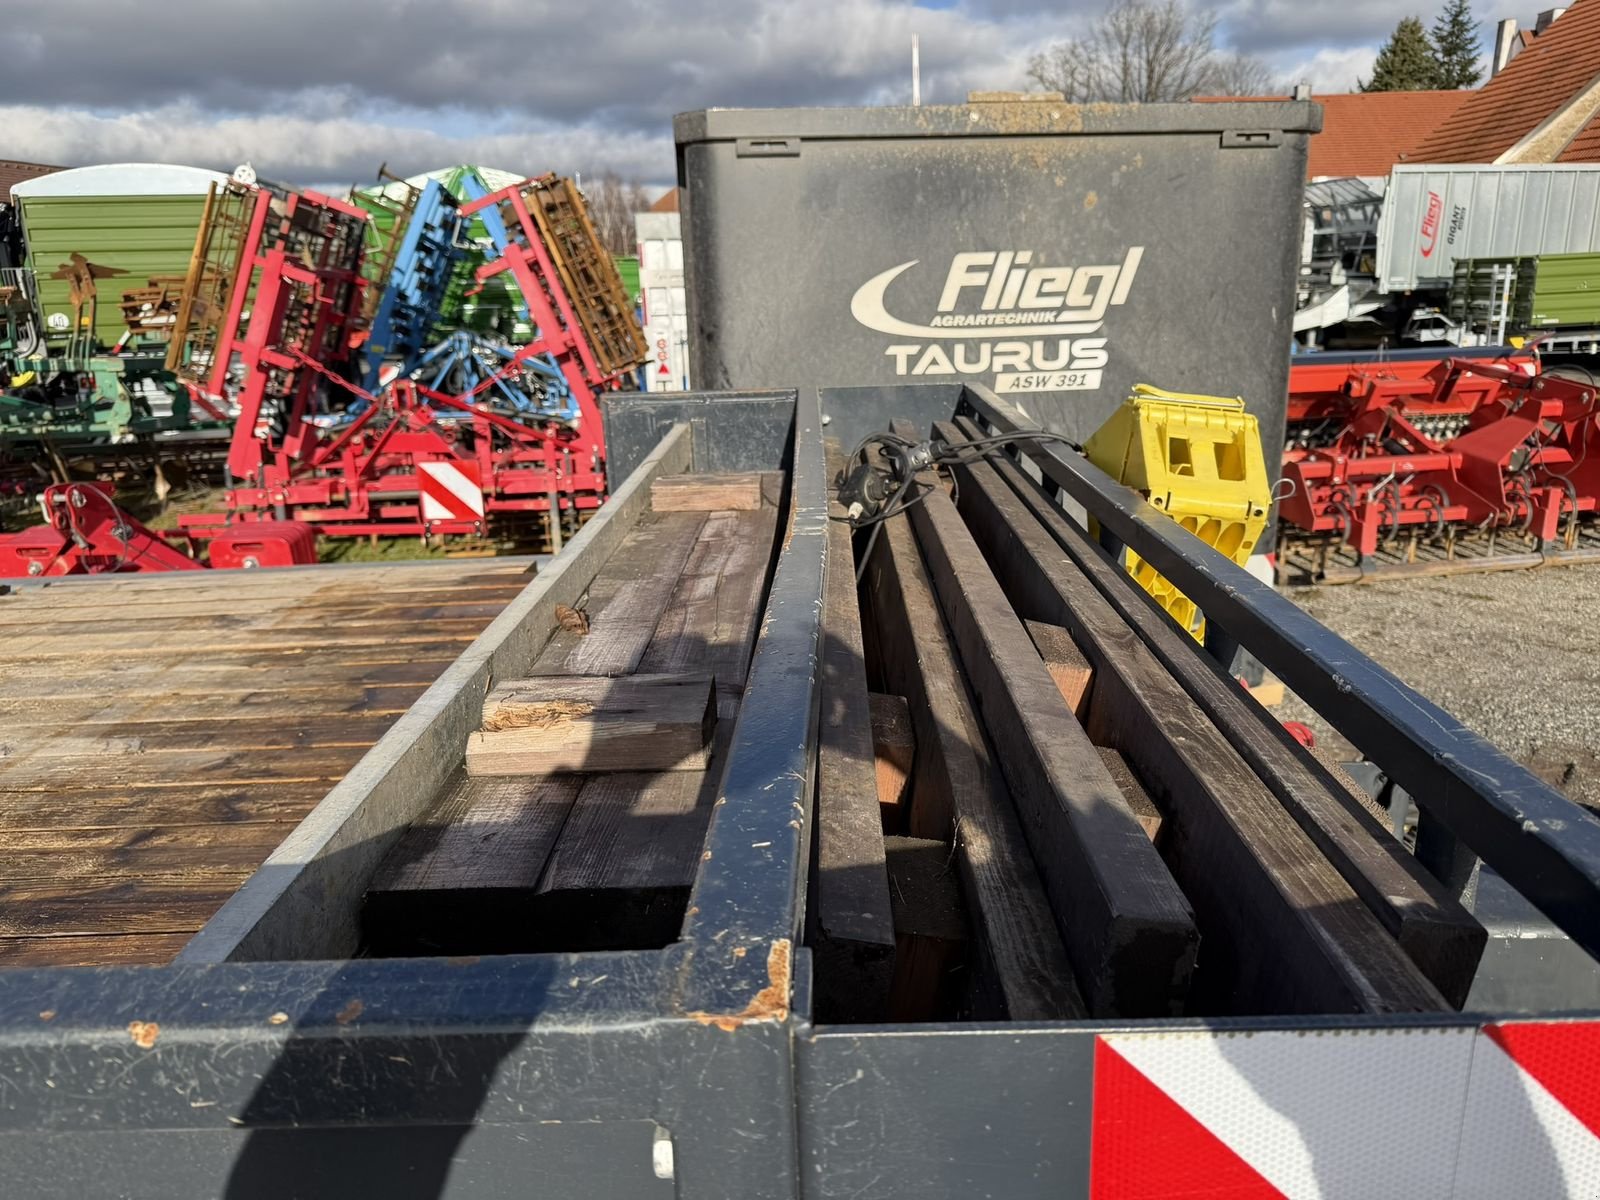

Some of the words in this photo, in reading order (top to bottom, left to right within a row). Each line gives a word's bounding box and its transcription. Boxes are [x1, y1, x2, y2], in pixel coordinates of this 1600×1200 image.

[1421, 190, 1441, 238] Fliegl
[1447, 203, 1461, 245] GIGANT
[937, 246, 1145, 322] Fliegl
[930, 311, 1058, 327] AGRARTECHNIK
[884, 337, 1109, 375] TAURUS
[1009, 375, 1052, 389] ASW
[1055, 373, 1087, 387] 391
